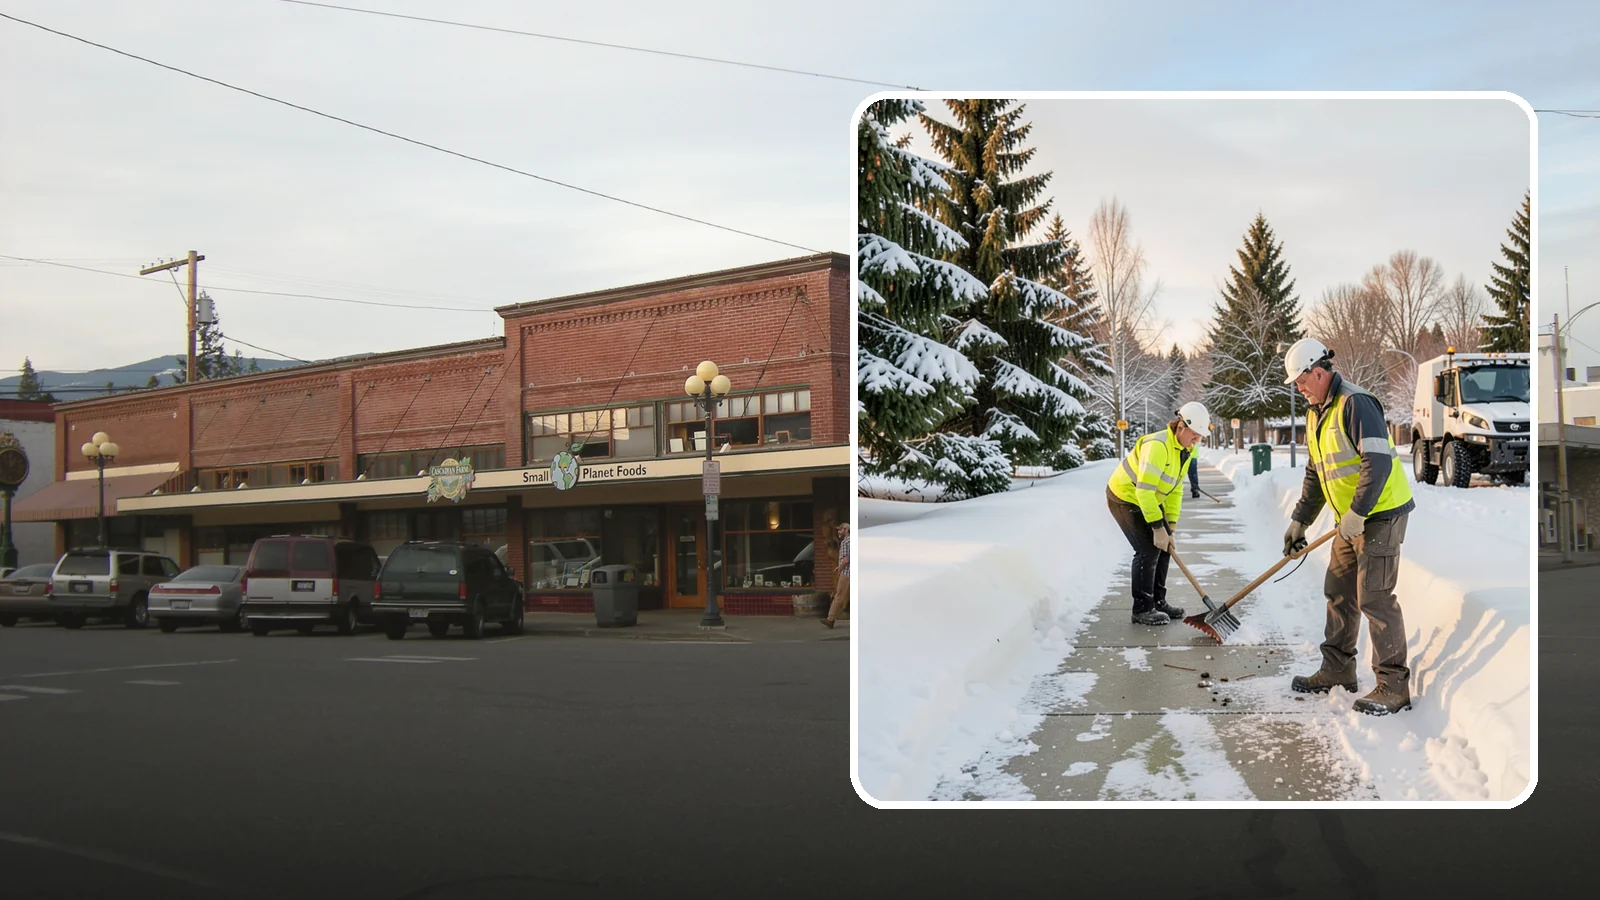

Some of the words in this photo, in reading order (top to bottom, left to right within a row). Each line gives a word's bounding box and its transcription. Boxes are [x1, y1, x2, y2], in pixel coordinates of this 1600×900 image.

[523, 471, 549, 482] Small
[582, 468, 614, 479] Planet
[616, 464, 647, 476] Foods
